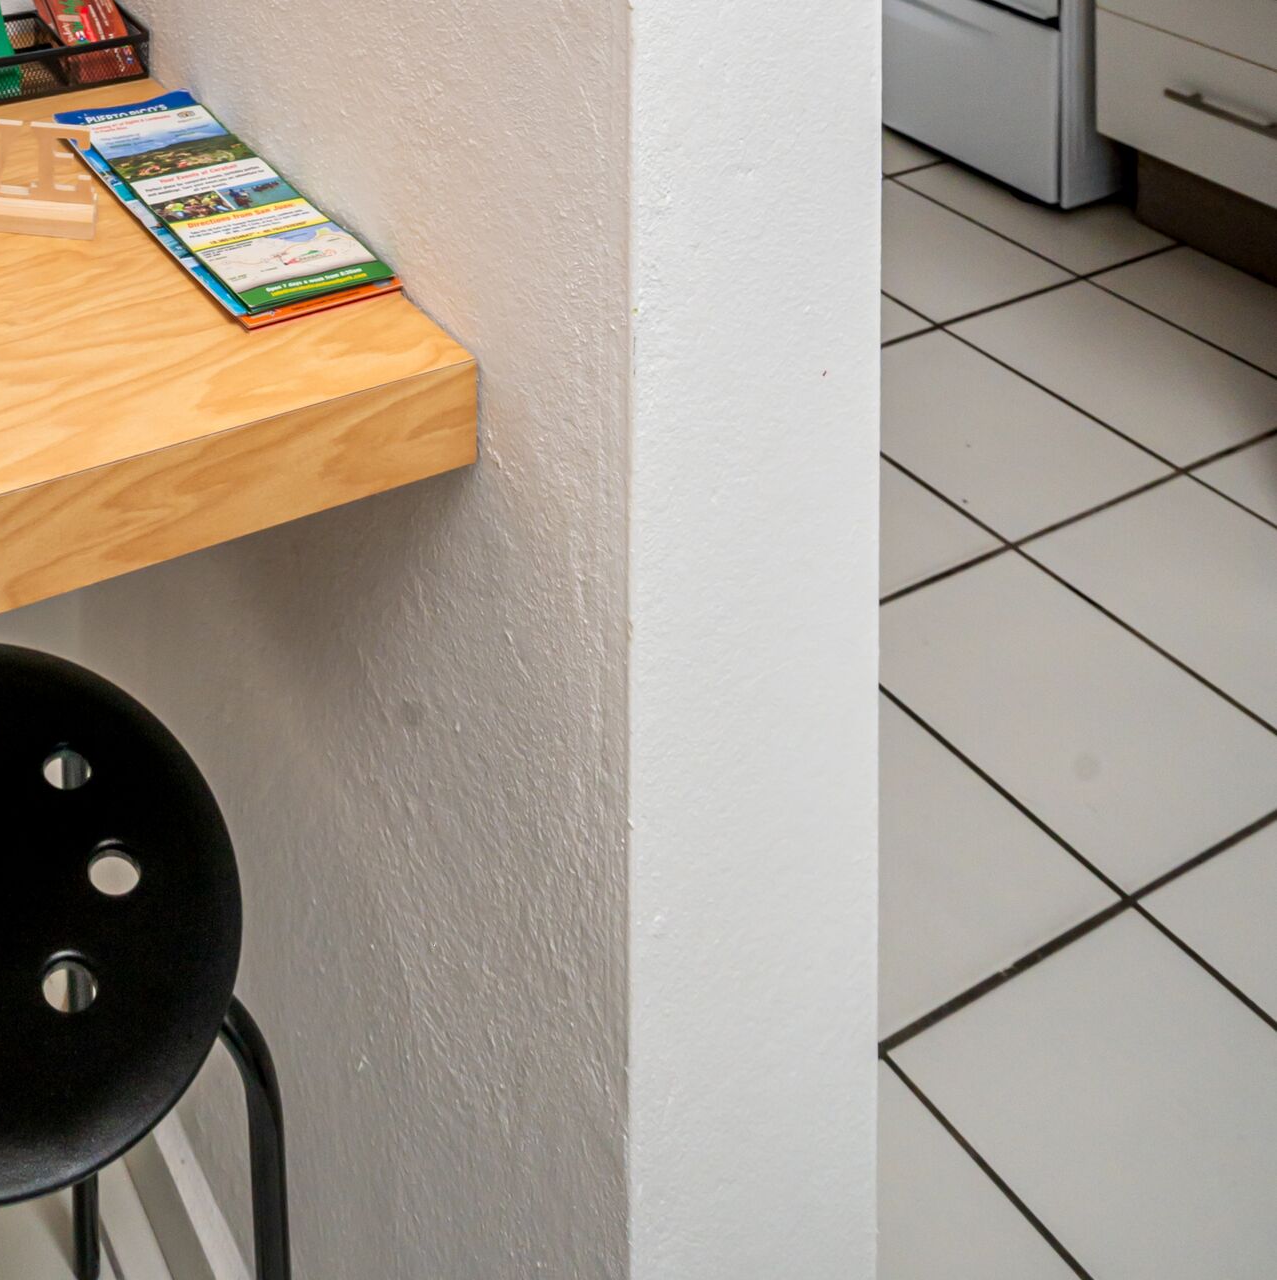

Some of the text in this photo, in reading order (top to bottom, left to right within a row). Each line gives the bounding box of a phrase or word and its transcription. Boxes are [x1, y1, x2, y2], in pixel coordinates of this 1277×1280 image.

[187, 214, 231, 229] Directions
[232, 209, 254, 220] from
[255, 206, 272, 216] San
